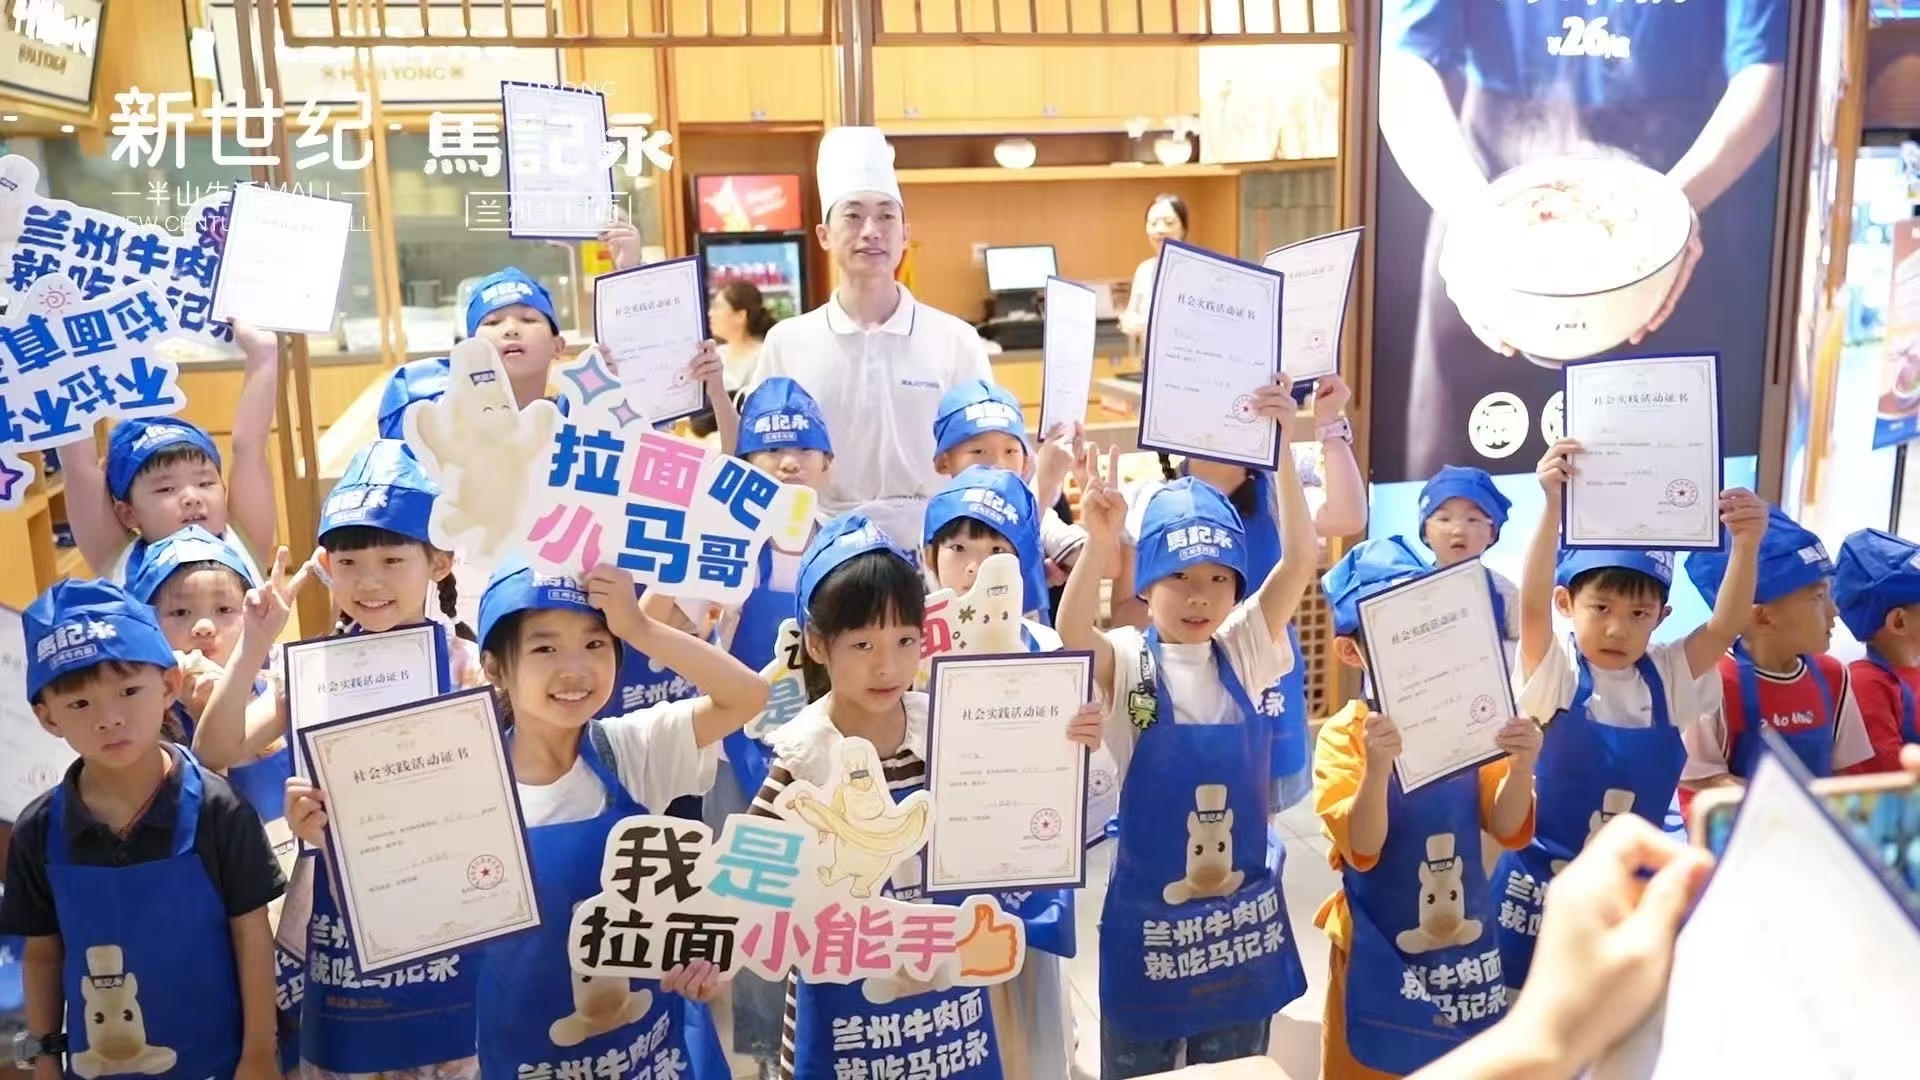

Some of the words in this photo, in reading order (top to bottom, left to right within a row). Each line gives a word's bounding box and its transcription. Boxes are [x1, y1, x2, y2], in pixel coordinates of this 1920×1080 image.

[527, 503, 752, 589] 小马哥
[962, 704, 1060, 721] 社会实践活动证书
[352, 747, 470, 784] 社会实践活动证书
[611, 823, 804, 908] 我是
[580, 902, 957, 976] 拉面小能手
[1143, 887, 1279, 947] 兰州牛肉面
[1144, 922, 1286, 980] 就吃马记永
[831, 988, 983, 1051] 兰州牛肉面
